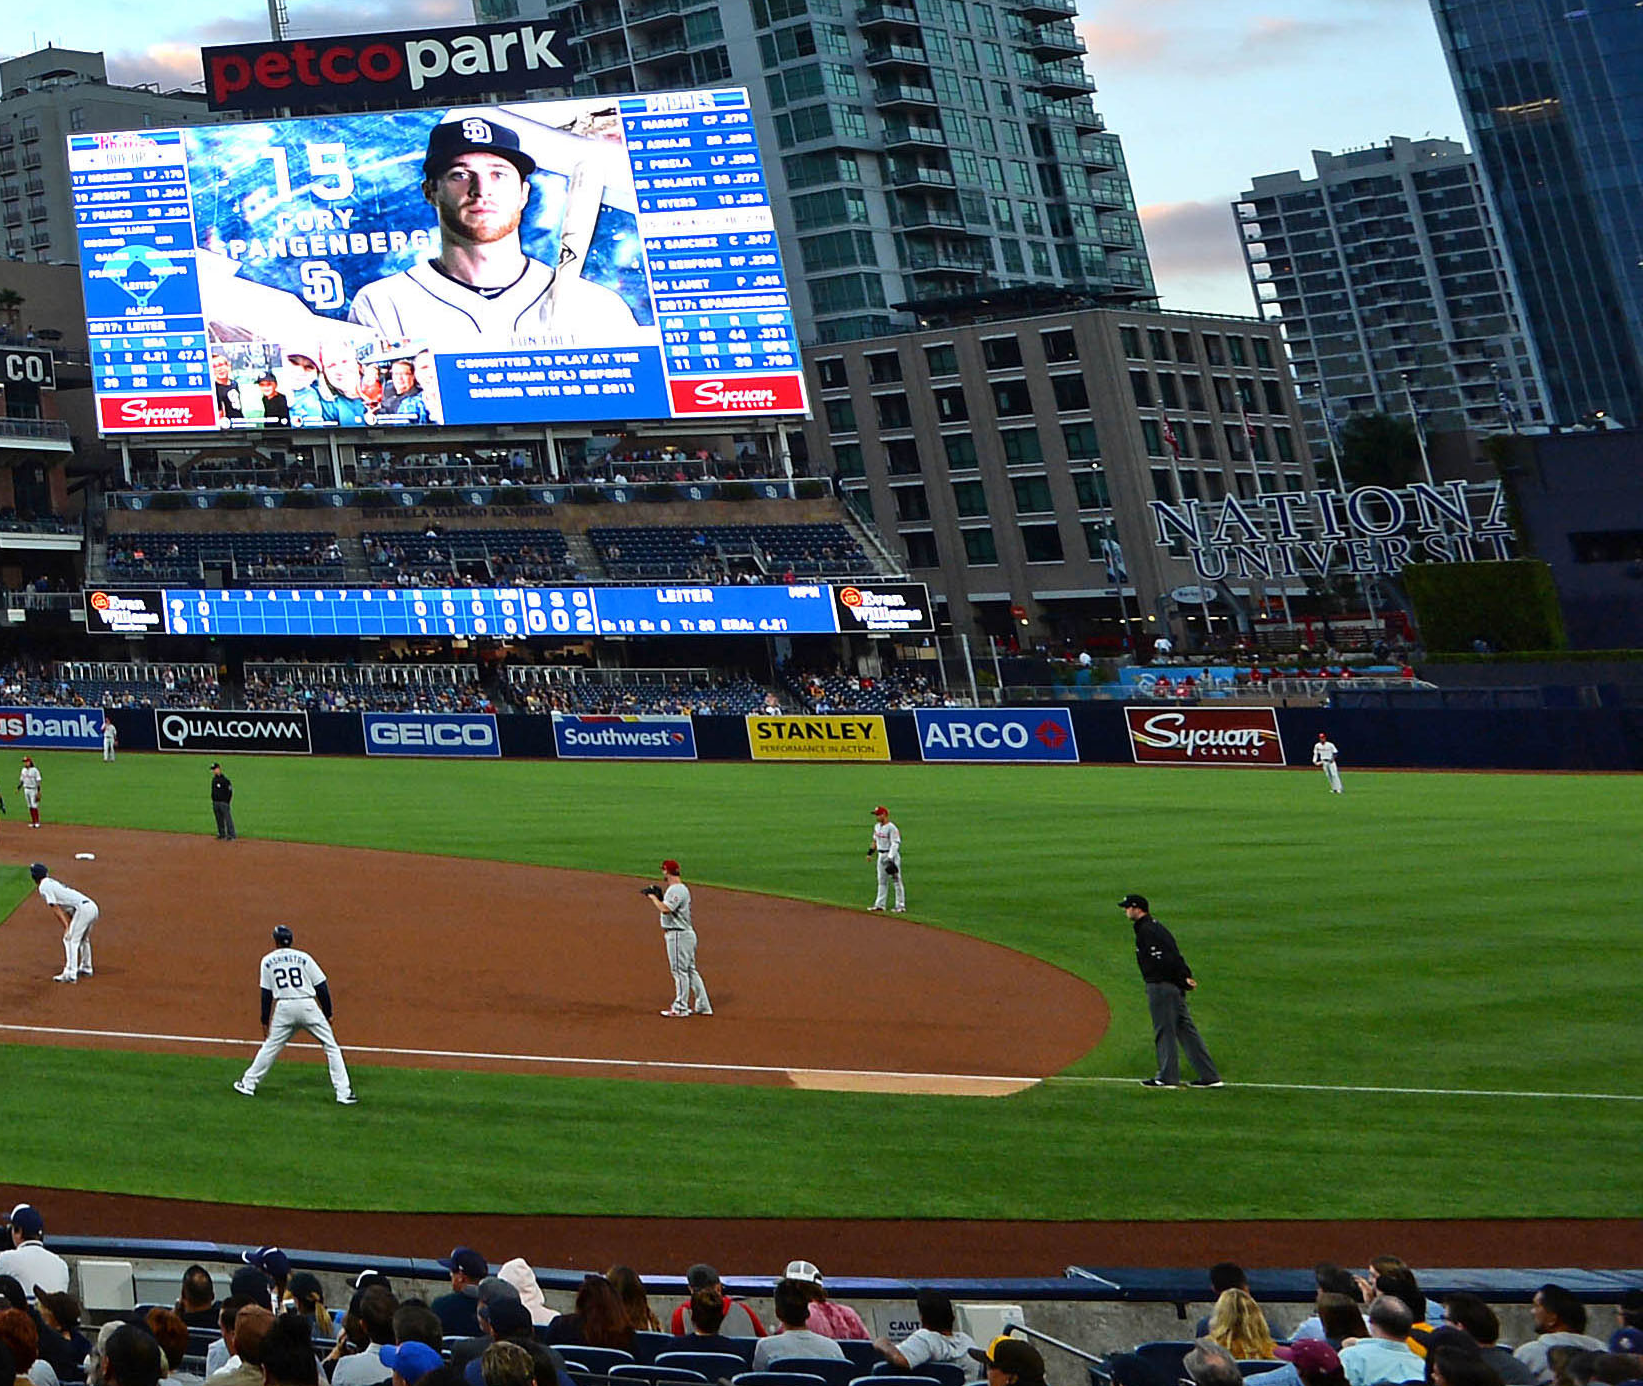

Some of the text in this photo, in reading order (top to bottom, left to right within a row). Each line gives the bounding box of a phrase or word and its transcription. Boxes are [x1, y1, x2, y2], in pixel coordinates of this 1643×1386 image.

[261, 142, 355, 203] 15
[276, 208, 354, 232] CORY
[5, 356, 53, 384] CO.
[554, 354, 589, 366] PLAY
[591, 353, 611, 364] AT
[612, 352, 640, 363] THE
[694, 381, 777, 410] Sycuan
[120, 399, 193, 426] Sycuan
[656, 588, 714, 603] LEITER
[162, 715, 303, 747] QUALCOMM
[370, 722, 493, 746] GEICO
[565, 727, 671, 747] Southwest
[756, 721, 874, 740] STANLEY
[924, 722, 1029, 749] ARCO
[1143, 713, 1266, 757] Sycuan
[760, 744, 875, 754] PERFORMANCE IN ACTION
[1200, 747, 1260, 757] CASINO
[273, 966, 304, 989] 28
[889, 1320, 921, 1331] CAUT
